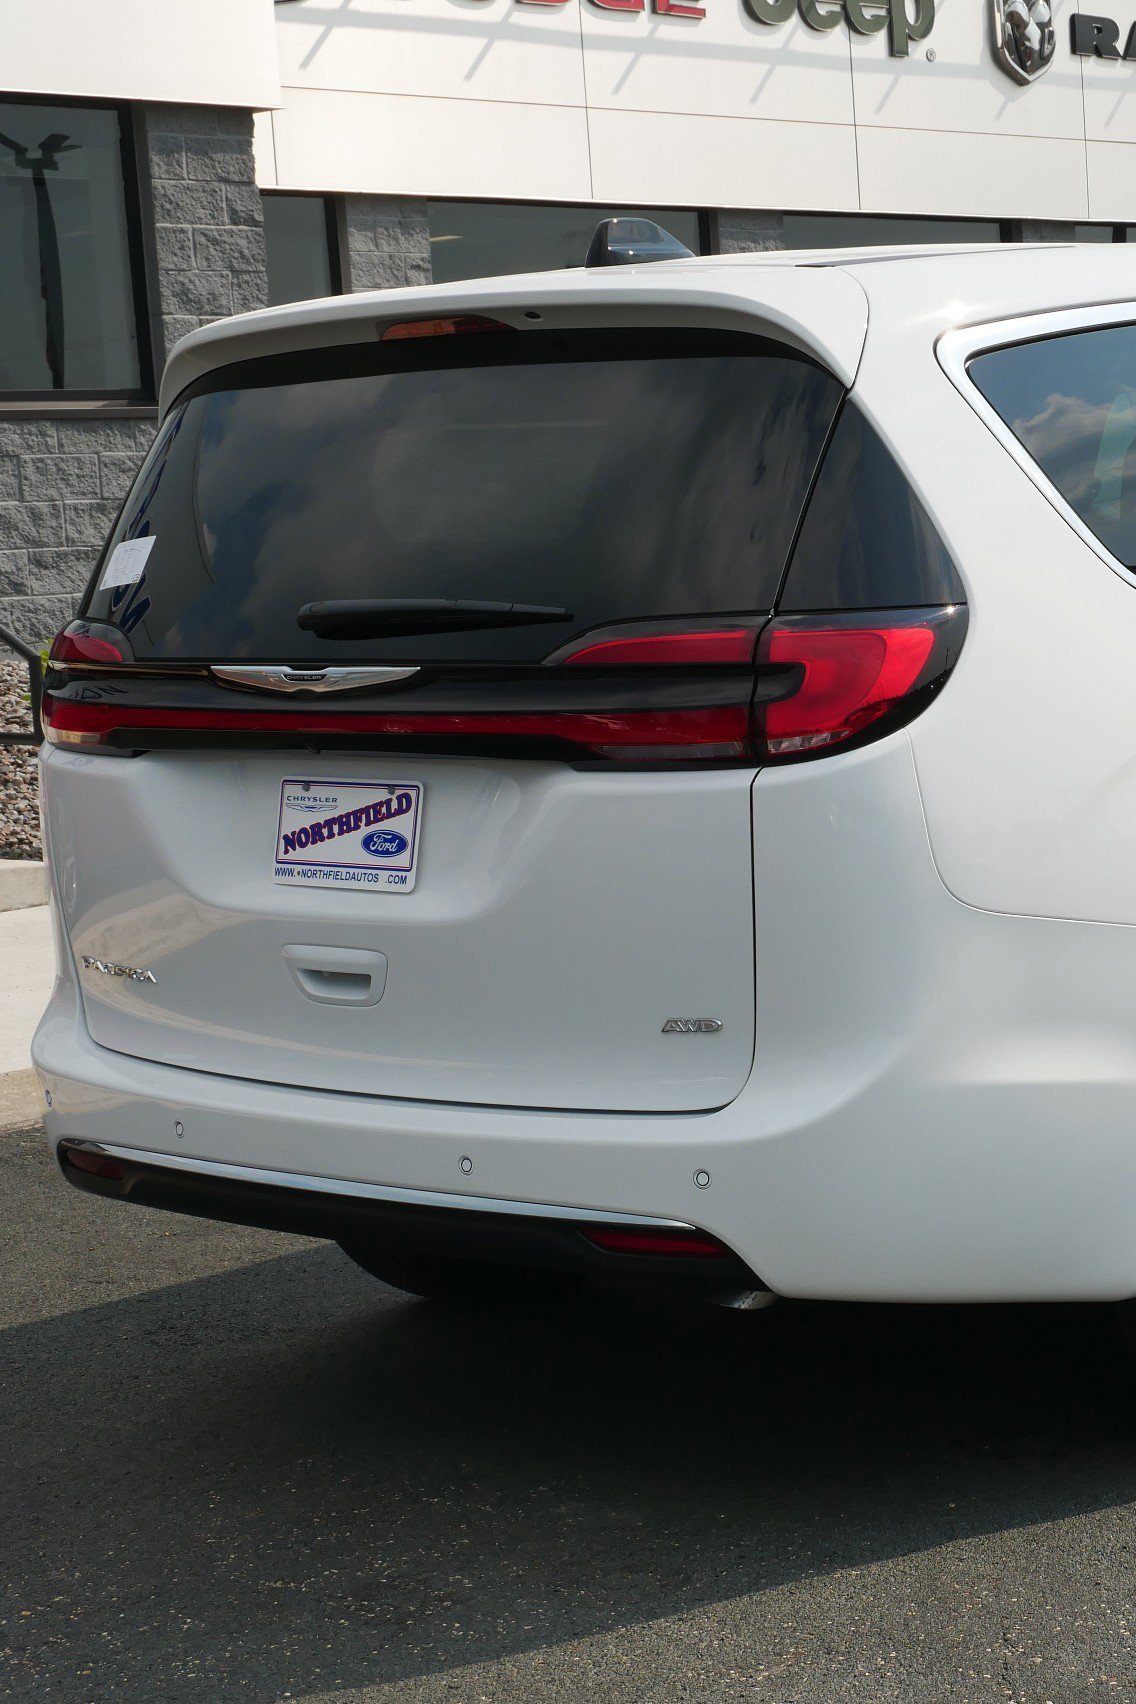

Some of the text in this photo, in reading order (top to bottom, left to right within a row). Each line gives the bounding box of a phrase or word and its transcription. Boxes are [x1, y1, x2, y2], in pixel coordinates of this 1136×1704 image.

[286, 795, 338, 804] CHRYSLER
[282, 792, 413, 855] NORTHFIELD
[369, 833, 398, 852] Ford
[661, 1018, 723, 1032] AWD
